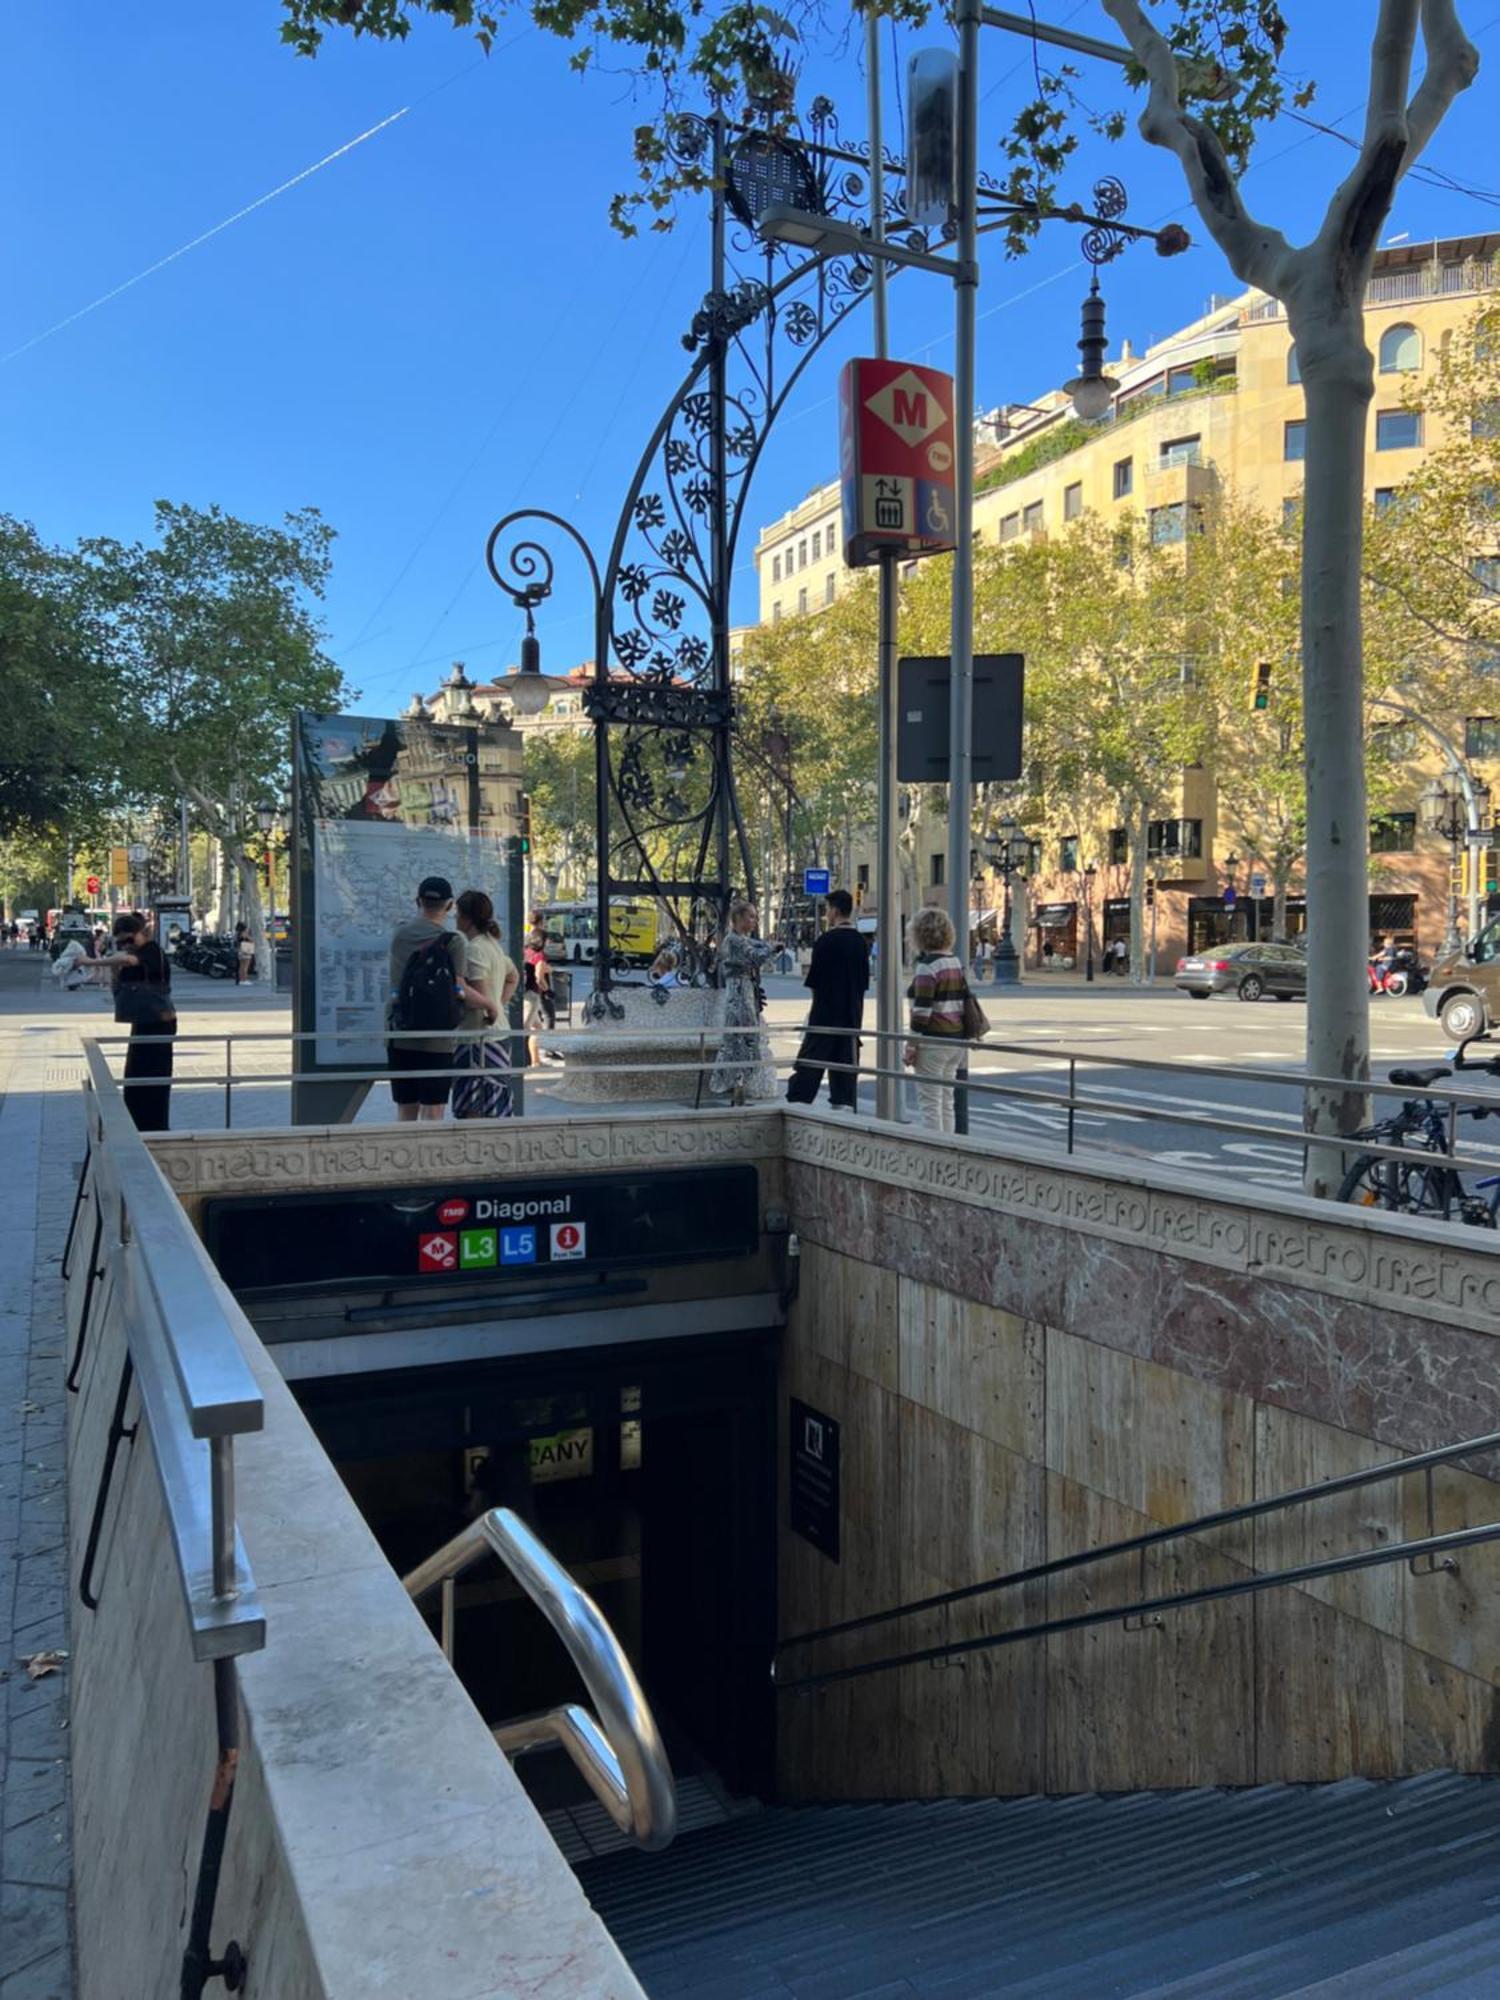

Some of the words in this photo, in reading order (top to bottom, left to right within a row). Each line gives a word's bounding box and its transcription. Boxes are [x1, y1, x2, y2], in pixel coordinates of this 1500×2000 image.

[893, 389, 928, 429] M
[476, 1194, 571, 1221] Diagonal
[431, 1242, 445, 1255] M
[464, 1236, 494, 1260] L3
[504, 1233, 534, 1256] L5
